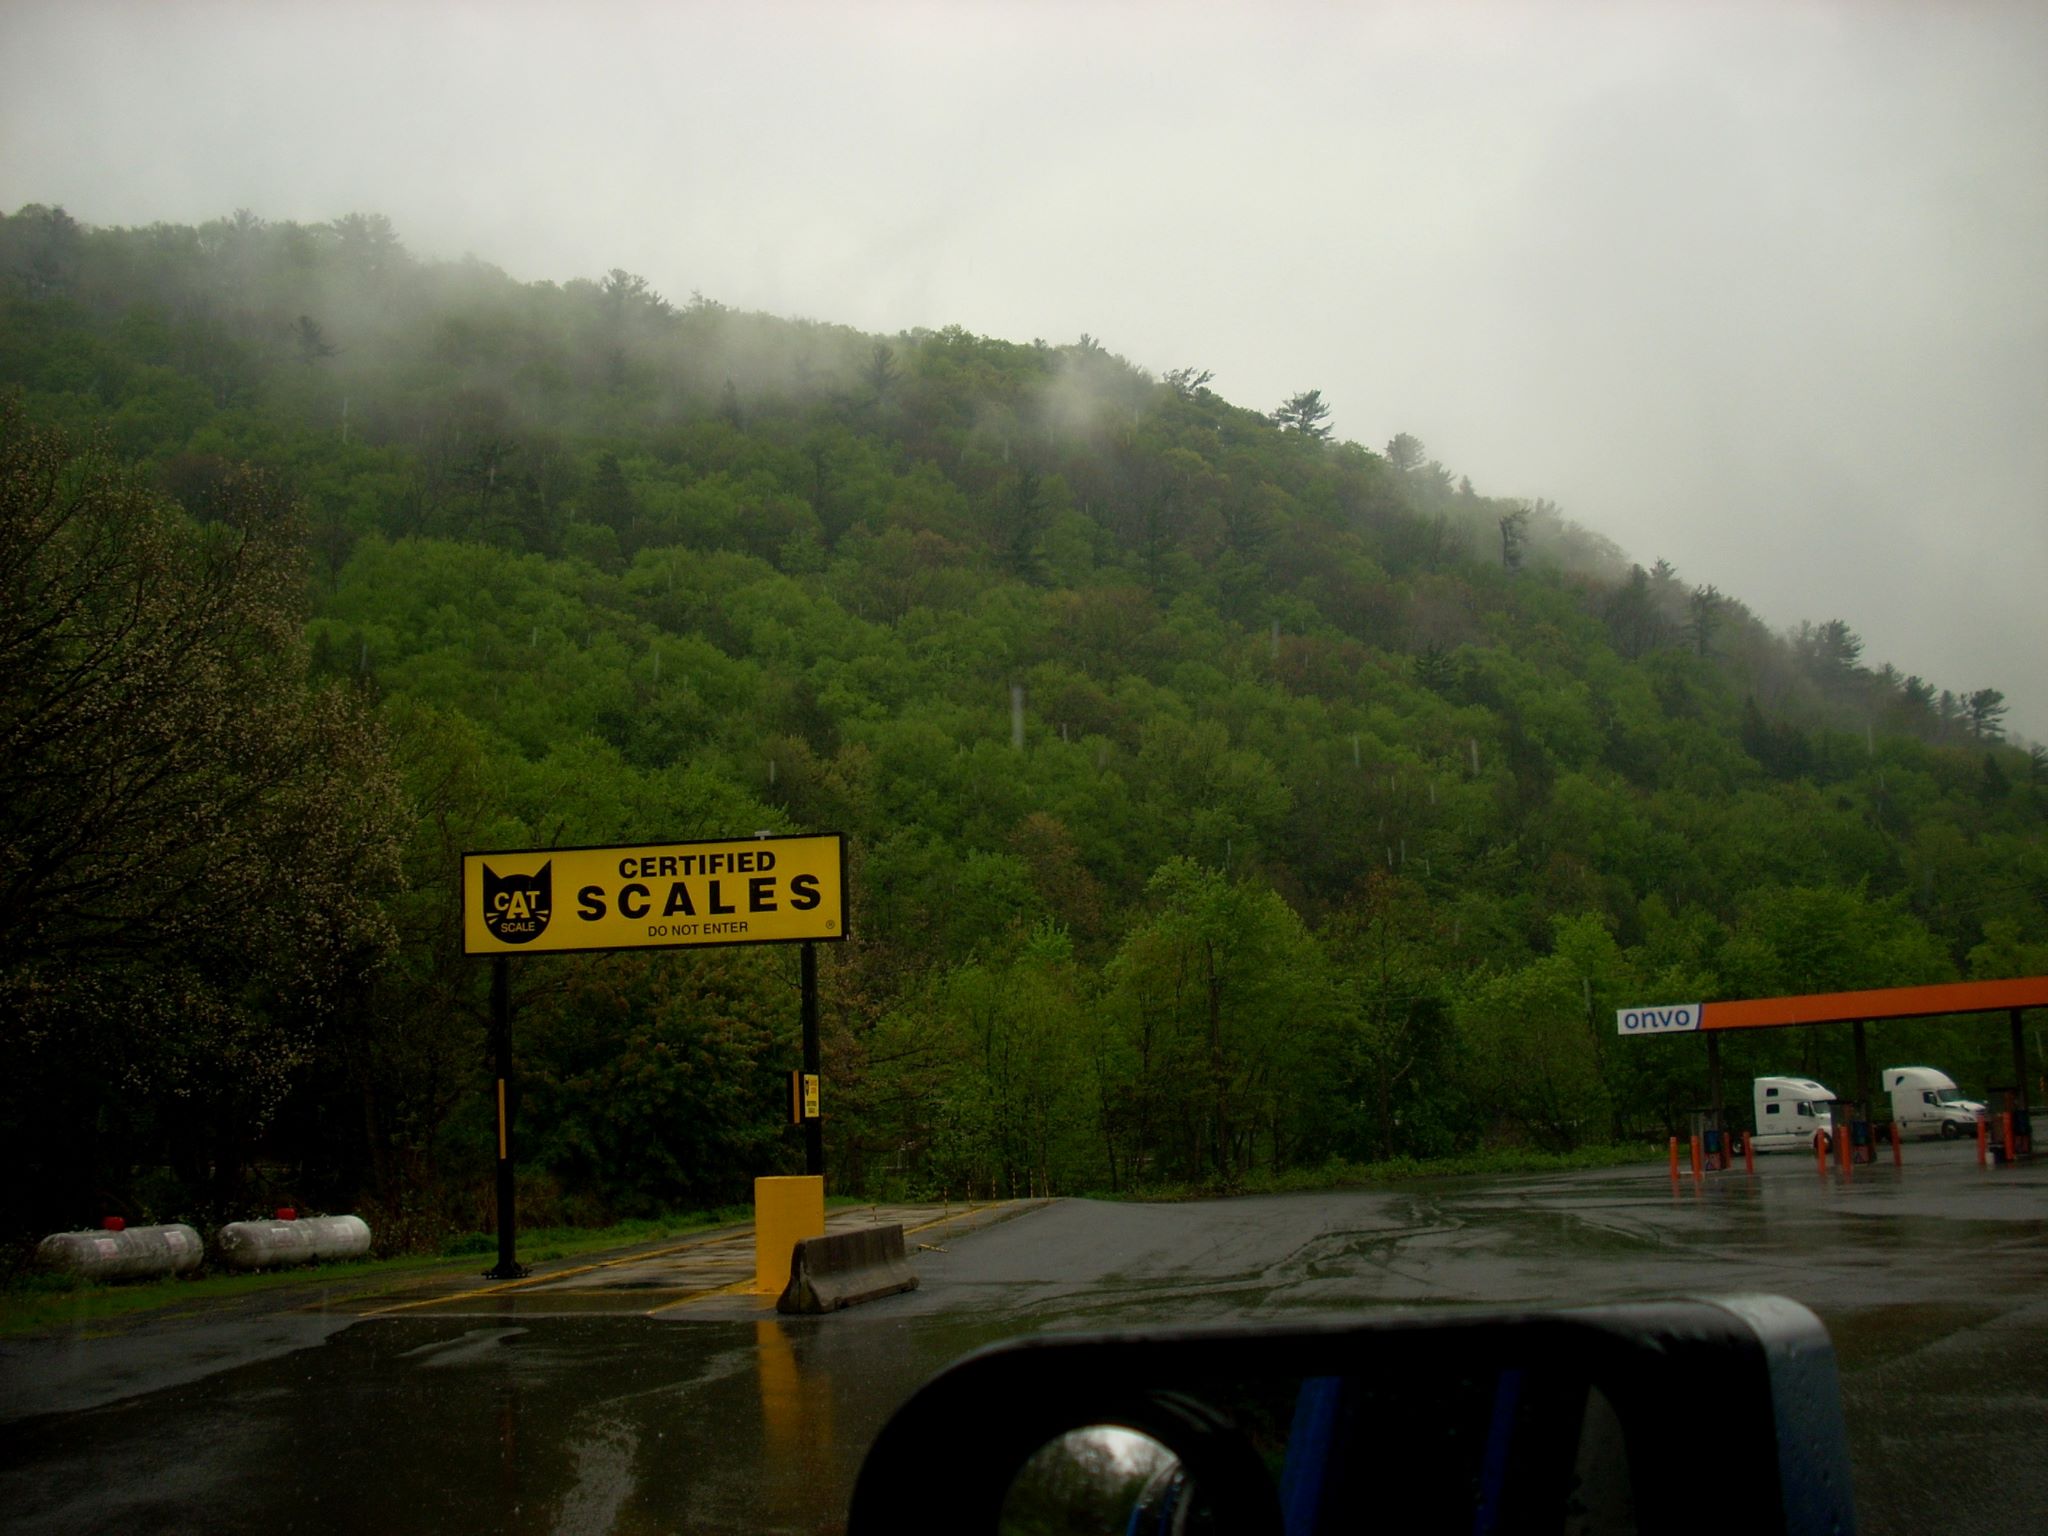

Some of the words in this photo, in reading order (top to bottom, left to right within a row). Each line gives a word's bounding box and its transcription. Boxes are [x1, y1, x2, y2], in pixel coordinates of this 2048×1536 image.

[619, 851, 776, 879] CERTIFIED
[493, 890, 541, 919] CAT
[577, 873, 822, 921] SCALES
[500, 921, 536, 933] SCALE
[648, 924, 668, 937] DO
[672, 923, 699, 936] NOT
[704, 921, 748, 934] ENTER
[1625, 1010, 1690, 1029] onvo
